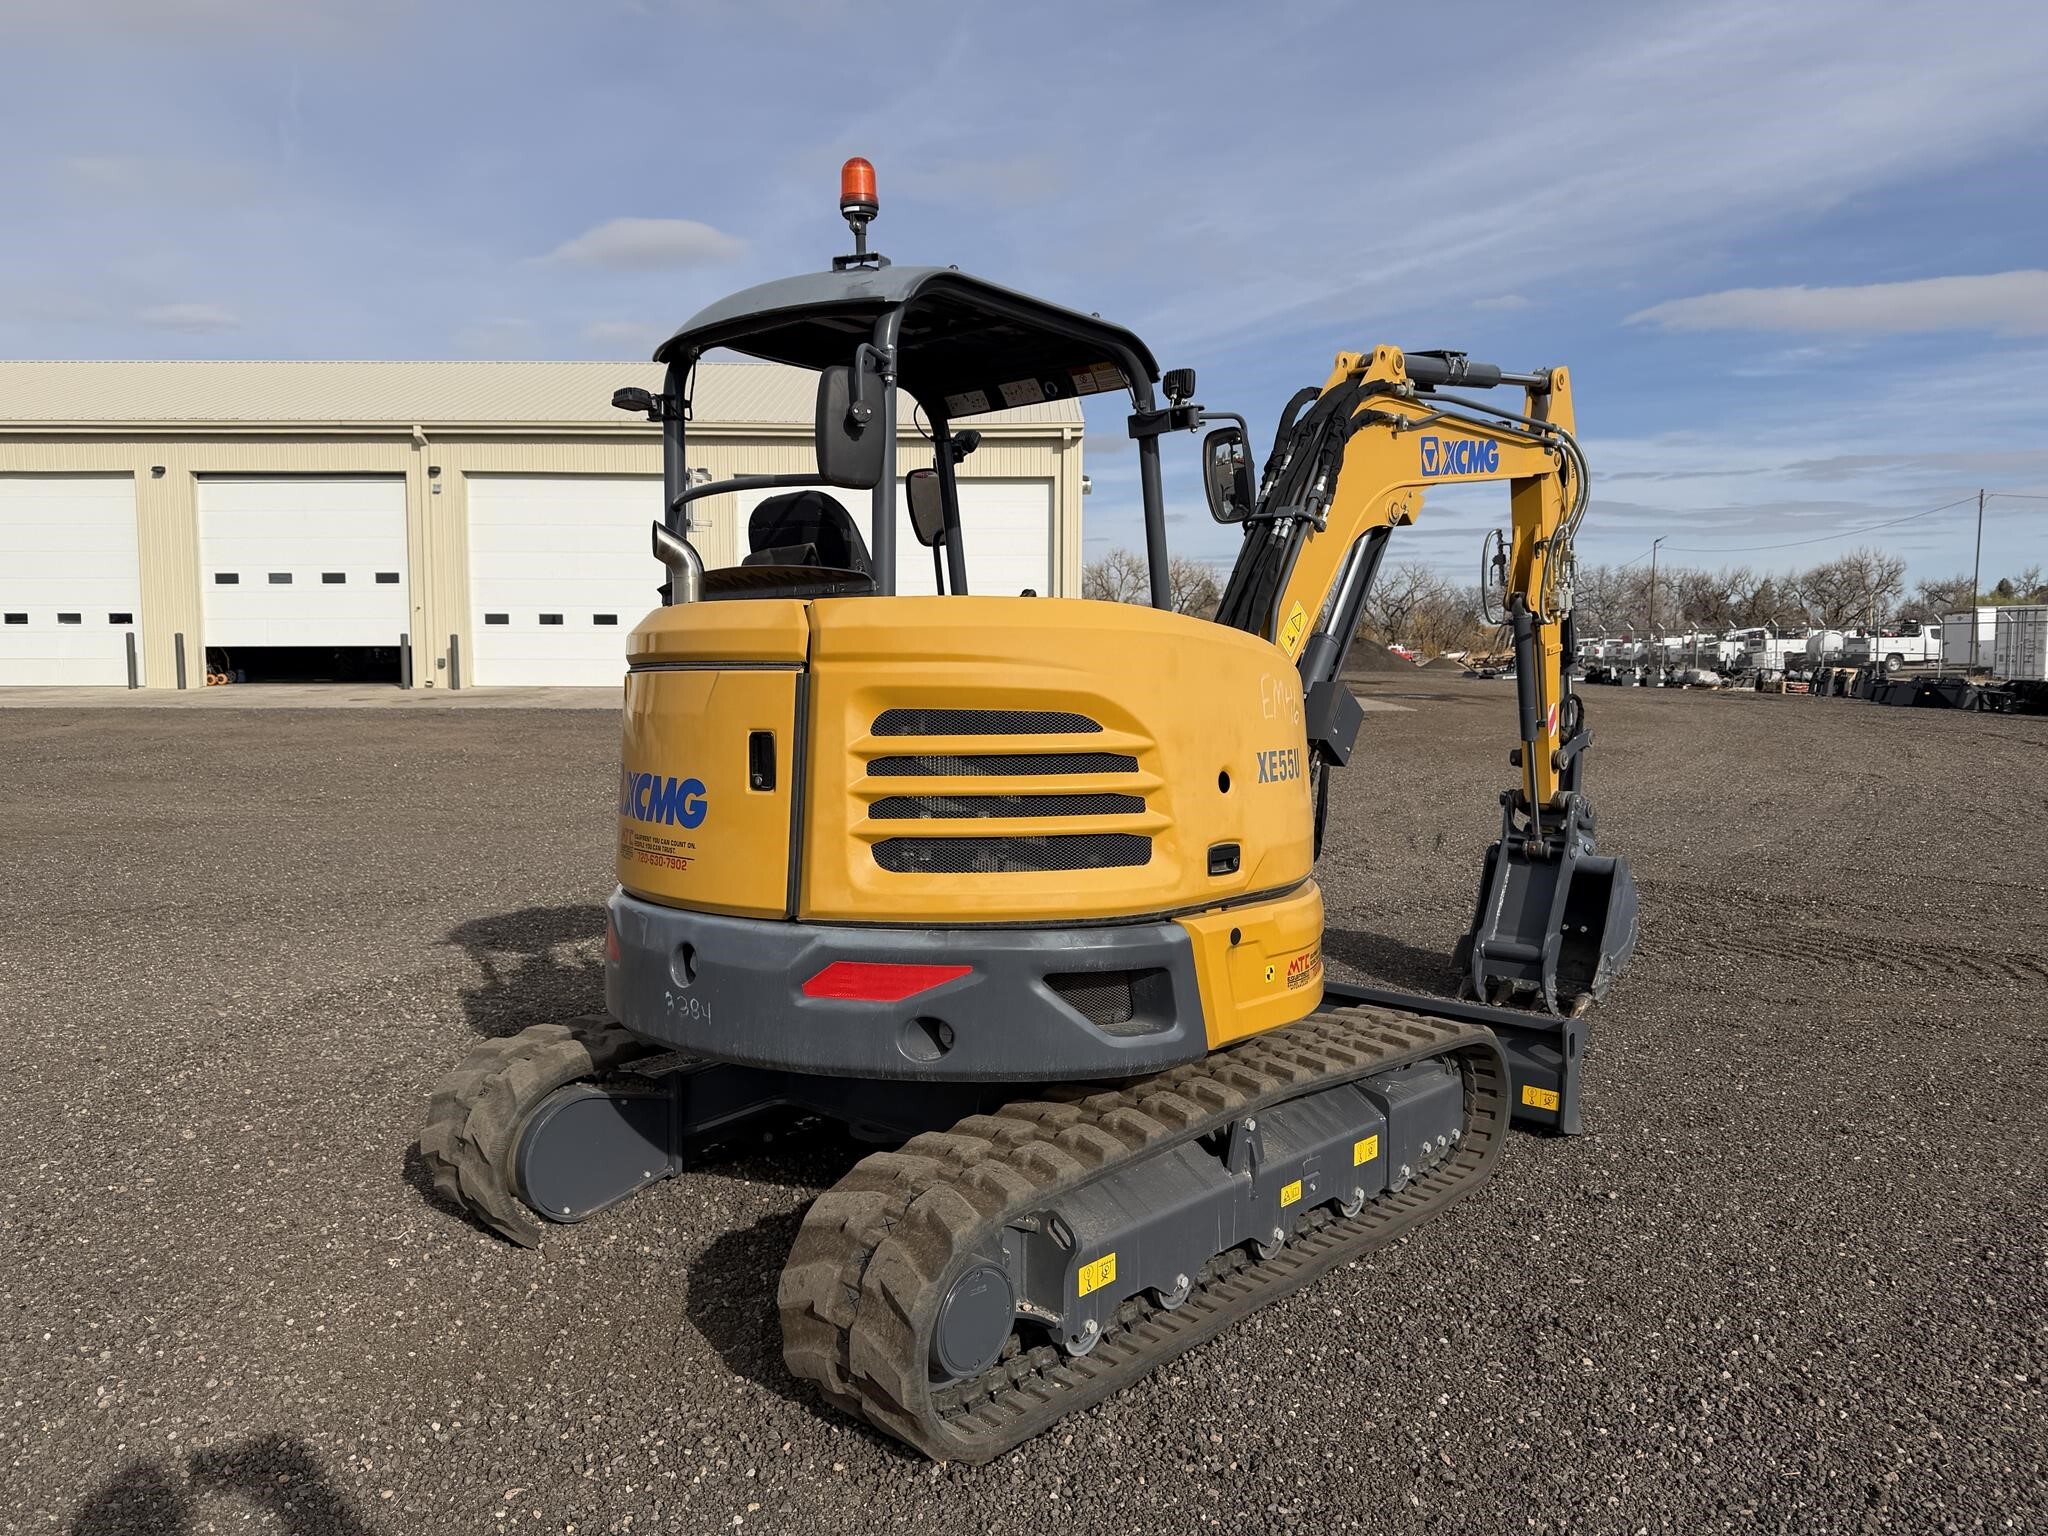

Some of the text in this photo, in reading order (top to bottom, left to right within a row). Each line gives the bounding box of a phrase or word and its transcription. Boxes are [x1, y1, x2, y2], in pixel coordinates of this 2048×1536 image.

[1440, 438, 1499, 475] XCMG
[1256, 748, 1300, 784] XE55U
[623, 771, 708, 829] XCMG
[661, 838, 670, 846] CAN
[671, 839, 687, 848] COUNT
